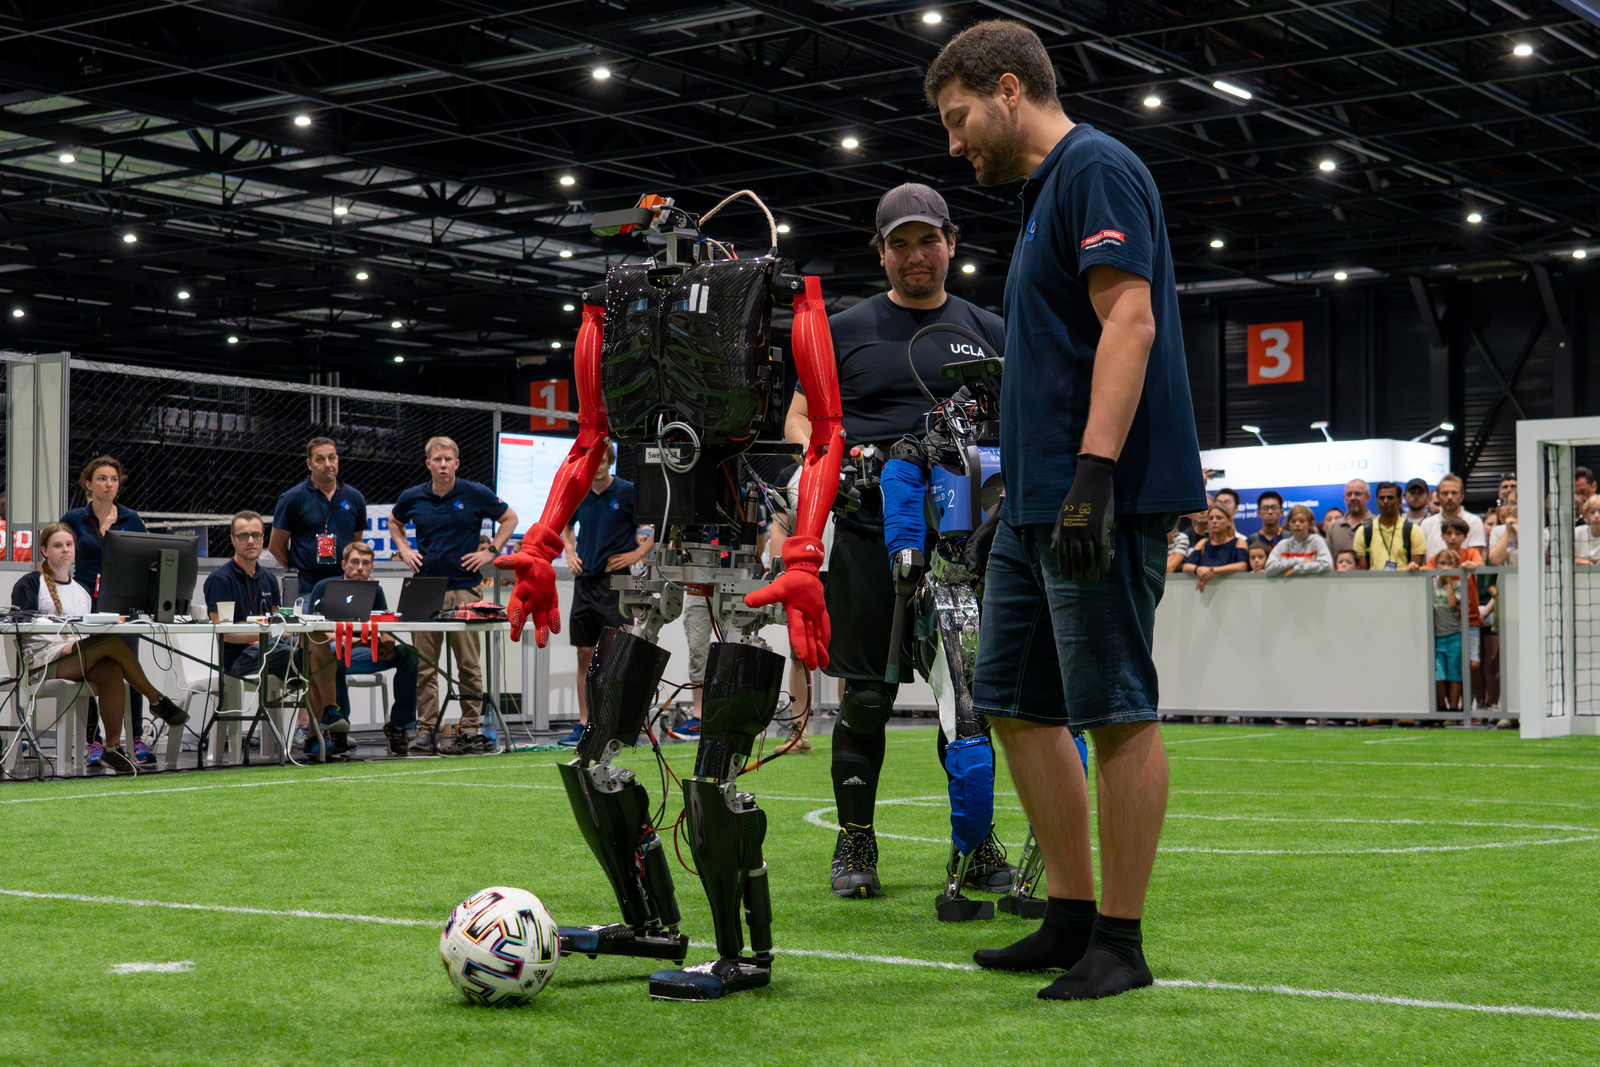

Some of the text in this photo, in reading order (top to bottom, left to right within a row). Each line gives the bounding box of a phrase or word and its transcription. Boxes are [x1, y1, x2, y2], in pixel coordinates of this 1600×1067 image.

[950, 343, 986, 358] UCLA
[1259, 327, 1291, 378] 3
[540, 384, 555, 425] 1
[1317, 459, 1368, 471] FESTO
[947, 489, 955, 508] 2
